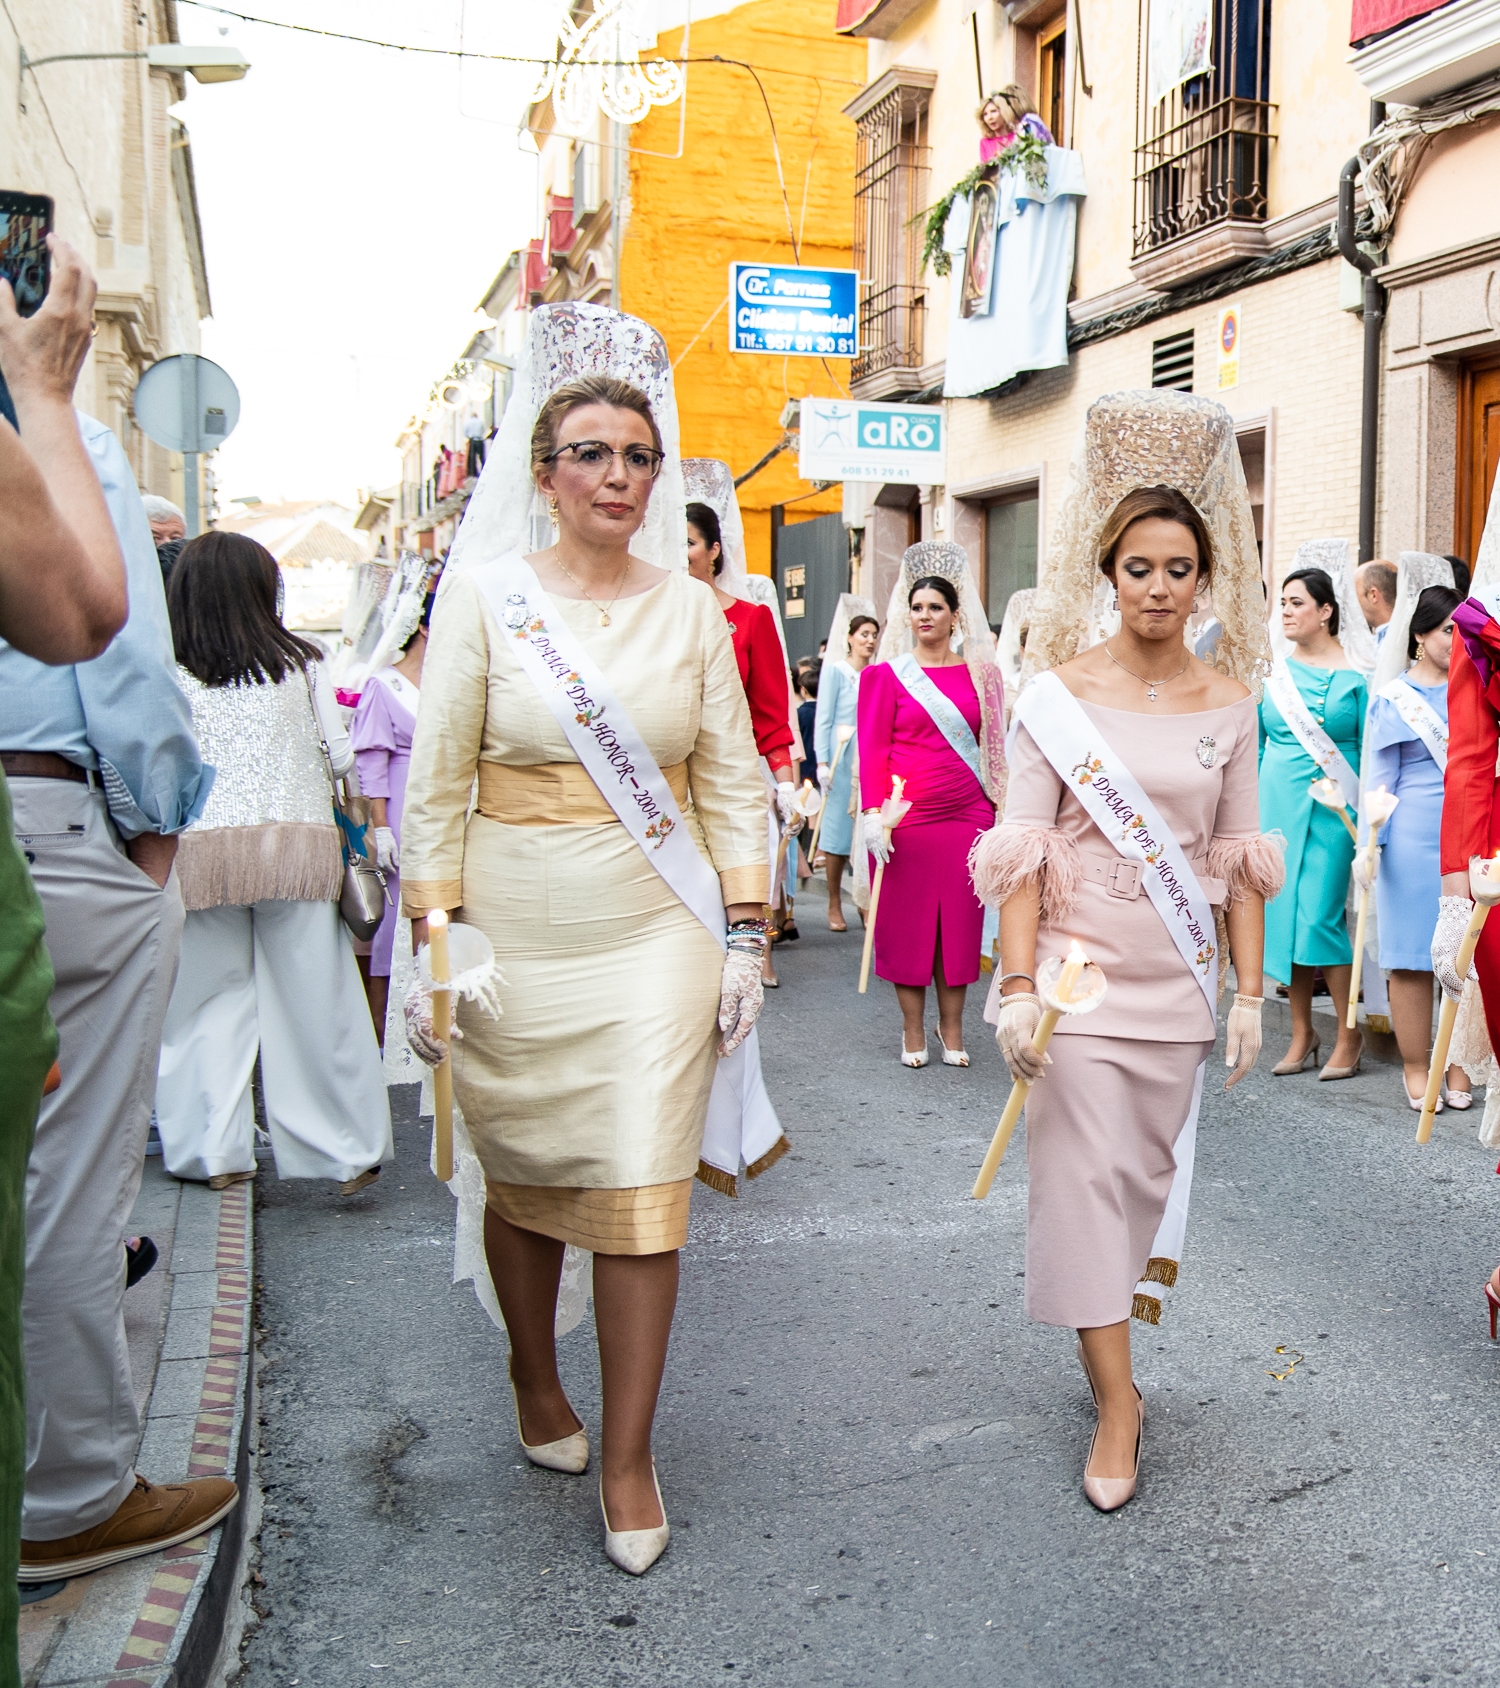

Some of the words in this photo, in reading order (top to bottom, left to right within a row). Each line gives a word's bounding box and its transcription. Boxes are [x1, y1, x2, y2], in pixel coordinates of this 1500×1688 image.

[747, 277, 770, 294] Dr.
[798, 310, 855, 333] Dental
[764, 333, 793, 350] 957
[795, 334, 812, 351] 51
[816, 335, 835, 352] 30
[838, 337, 854, 353] 81
[863, 415, 934, 448] aRo
[841, 466, 862, 476] 608
[865, 467, 877, 476] 51
[881, 467, 895, 477] 29
[897, 469, 910, 478] 41
[531, 636, 570, 679] DAMA
[566, 685, 595, 712] DE
[1093, 777, 1136, 825] DAMA
[1133, 829, 1157, 853] DE
